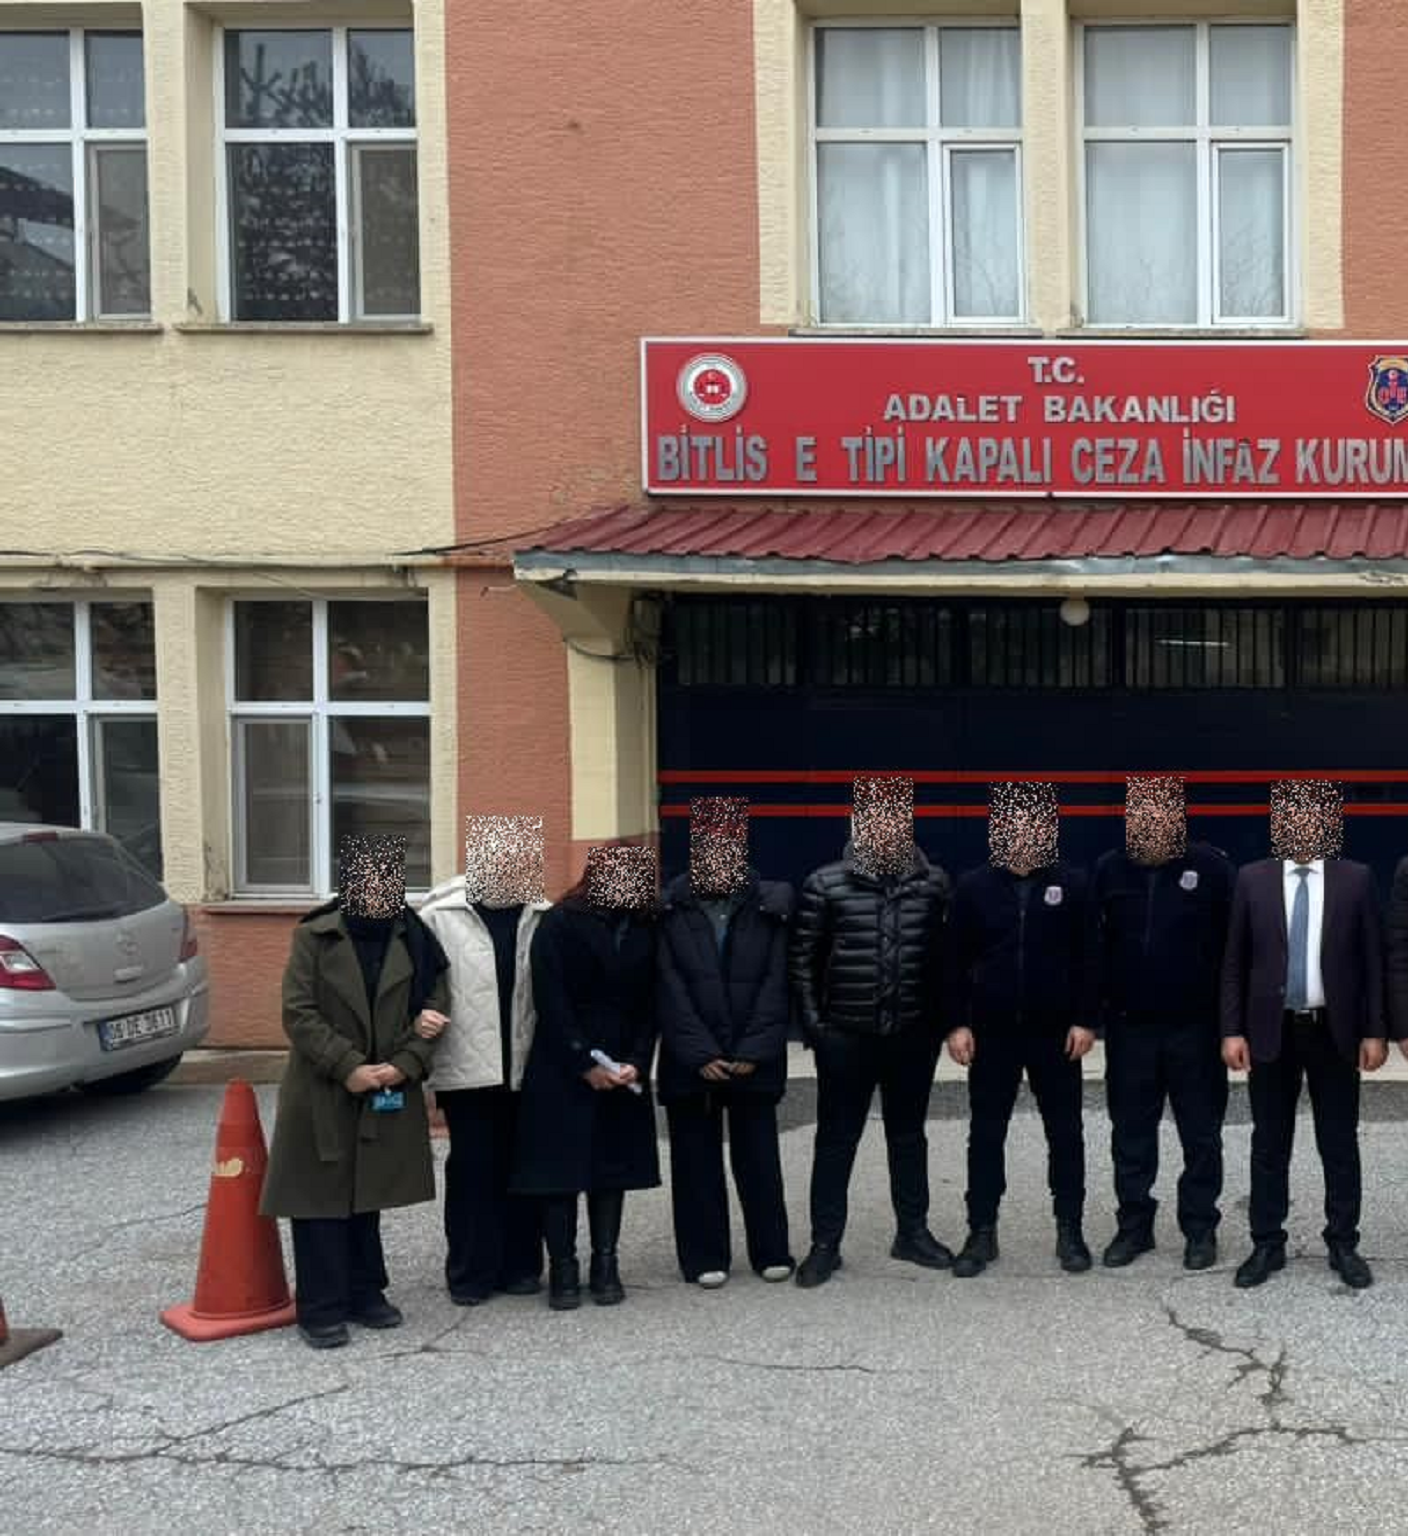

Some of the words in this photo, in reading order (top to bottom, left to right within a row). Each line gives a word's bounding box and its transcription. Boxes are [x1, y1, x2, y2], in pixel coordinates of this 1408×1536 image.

[1028, 356, 1085, 384] T.C.
[883, 394, 1023, 423] ADALET
[1043, 389, 1236, 424] BAKANLIĞI
[657, 425, 768, 483] BİTLİS
[796, 437, 818, 483] E
[842, 426, 906, 483] TİPİ
[925, 437, 1053, 484] KAPALI
[1071, 437, 1165, 485] CEZA
